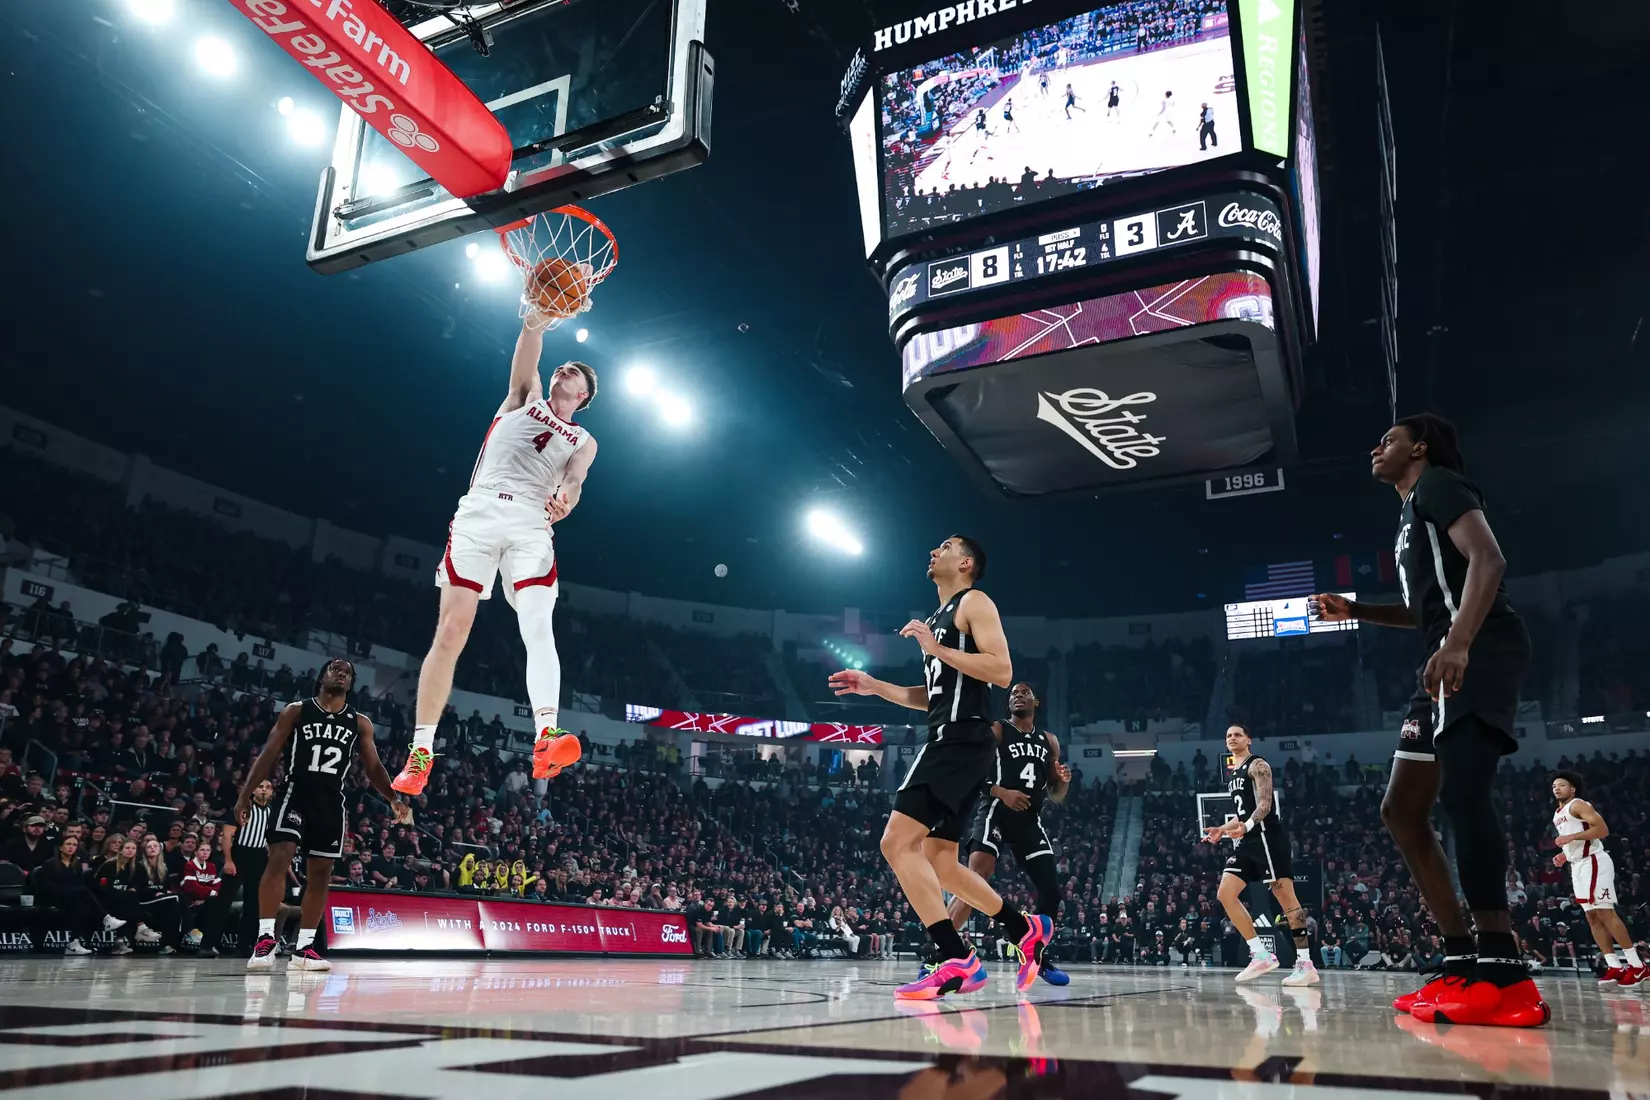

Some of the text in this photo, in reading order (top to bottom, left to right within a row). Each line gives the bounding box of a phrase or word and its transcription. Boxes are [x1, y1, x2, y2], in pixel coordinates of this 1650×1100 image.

[874, 0, 1033, 51] HUMPHRE
[290, 33, 395, 114] State
[1257, 33, 1279, 150] REGIONS
[1127, 221, 1144, 247] 3
[1167, 210, 1198, 239] A
[1015, 243, 1021, 253] 1
[1057, 239, 1075, 251] HALF
[1100, 233, 1110, 241] FLS
[982, 254, 998, 279] 8
[1013, 252, 1024, 260] FLS
[1036, 247, 1087, 275] 17:42
[931, 267, 968, 290] State
[526, 406, 579, 446] ALABAMA
[1036, 387, 1167, 470] State
[532, 430, 554, 454] 4
[1224, 473, 1265, 491] 1996
[498, 492, 514, 501] RTR
[28, 584, 47, 597] 116
[303, 722, 353, 745] STATE
[774, 720, 809, 738] LOUD
[307, 744, 343, 775] 12
[1008, 742, 1049, 763] STATE
[1019, 763, 1037, 789] 4
[1234, 794, 1246, 816] 2
[1597, 888, 1611, 900] A
[365, 908, 402, 933] State
[437, 918, 472, 930] WITH
[479, 920, 486, 930] A
[493, 921, 521, 932] 2024
[526, 923, 556, 933] FORD
[600, 926, 631, 937] TRUCK
[661, 923, 688, 944] Ford
